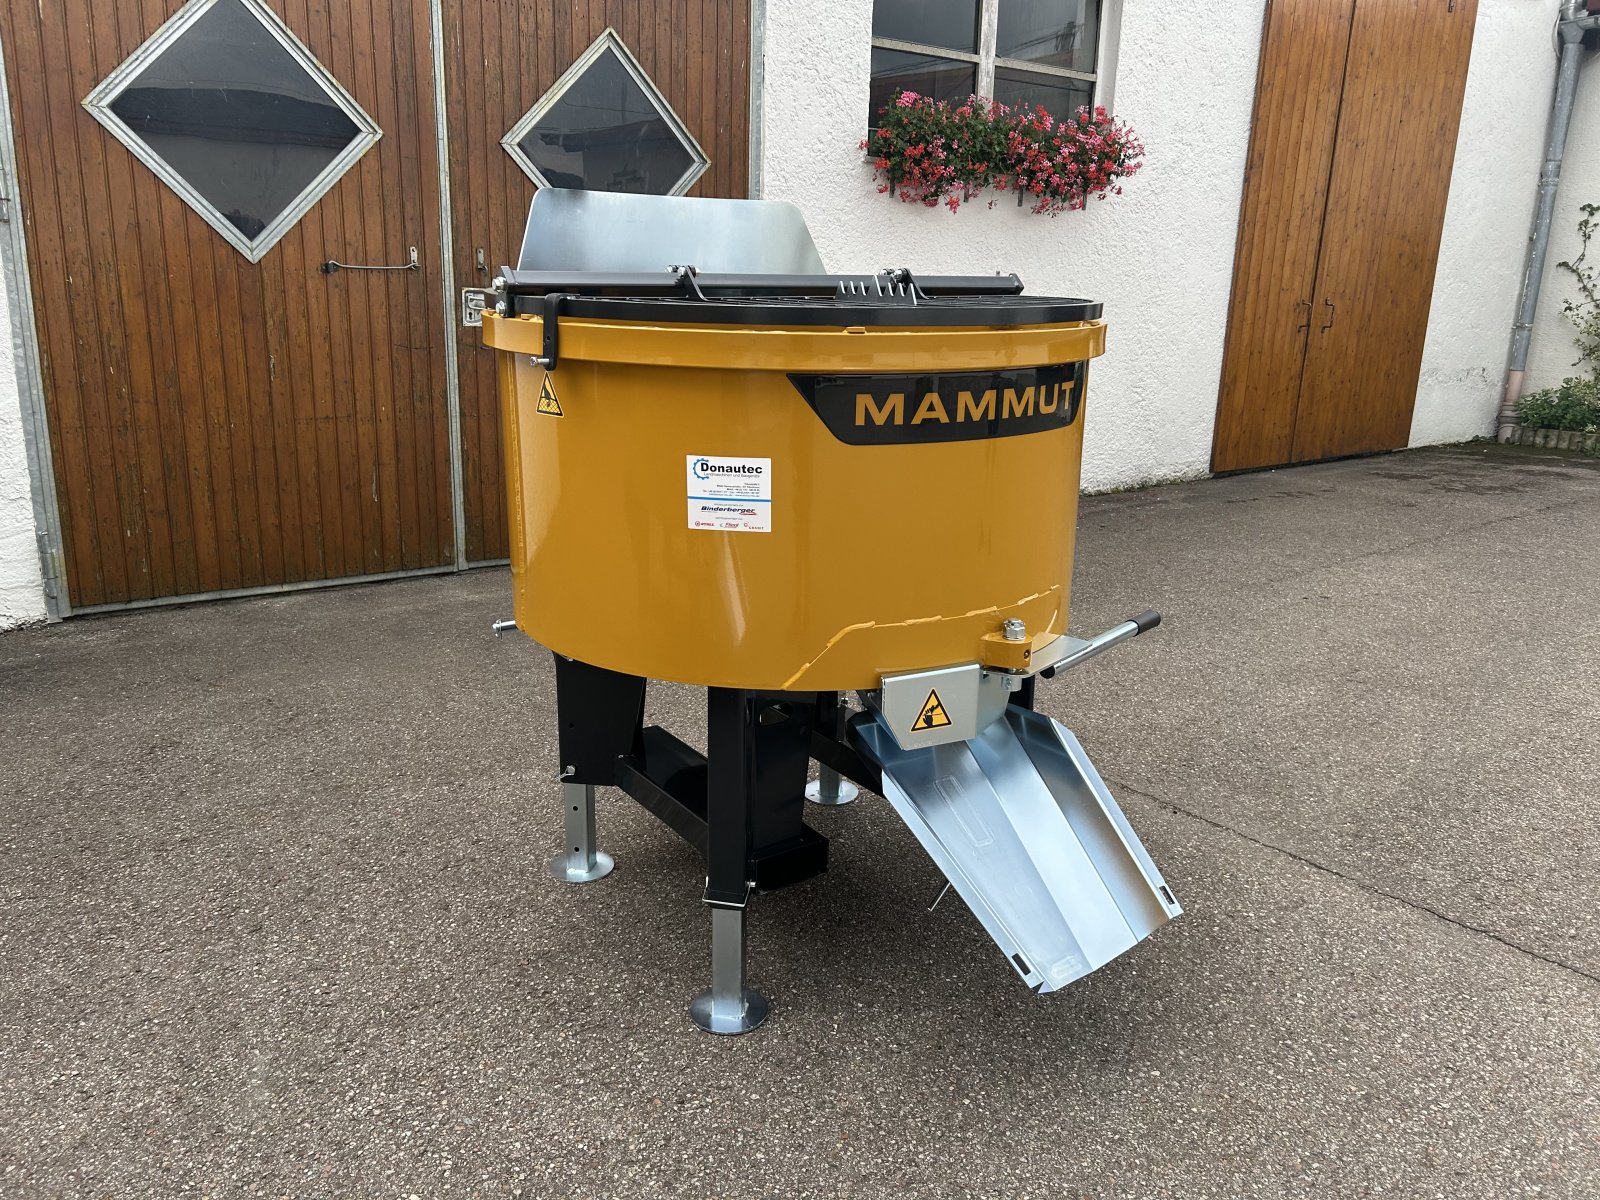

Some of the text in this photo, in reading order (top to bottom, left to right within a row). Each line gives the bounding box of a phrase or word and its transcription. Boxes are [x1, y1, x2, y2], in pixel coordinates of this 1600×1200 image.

[854, 380, 1075, 426] MAMMUT
[700, 462, 763, 474] Donautec
[701, 505, 756, 514] Binderberger
